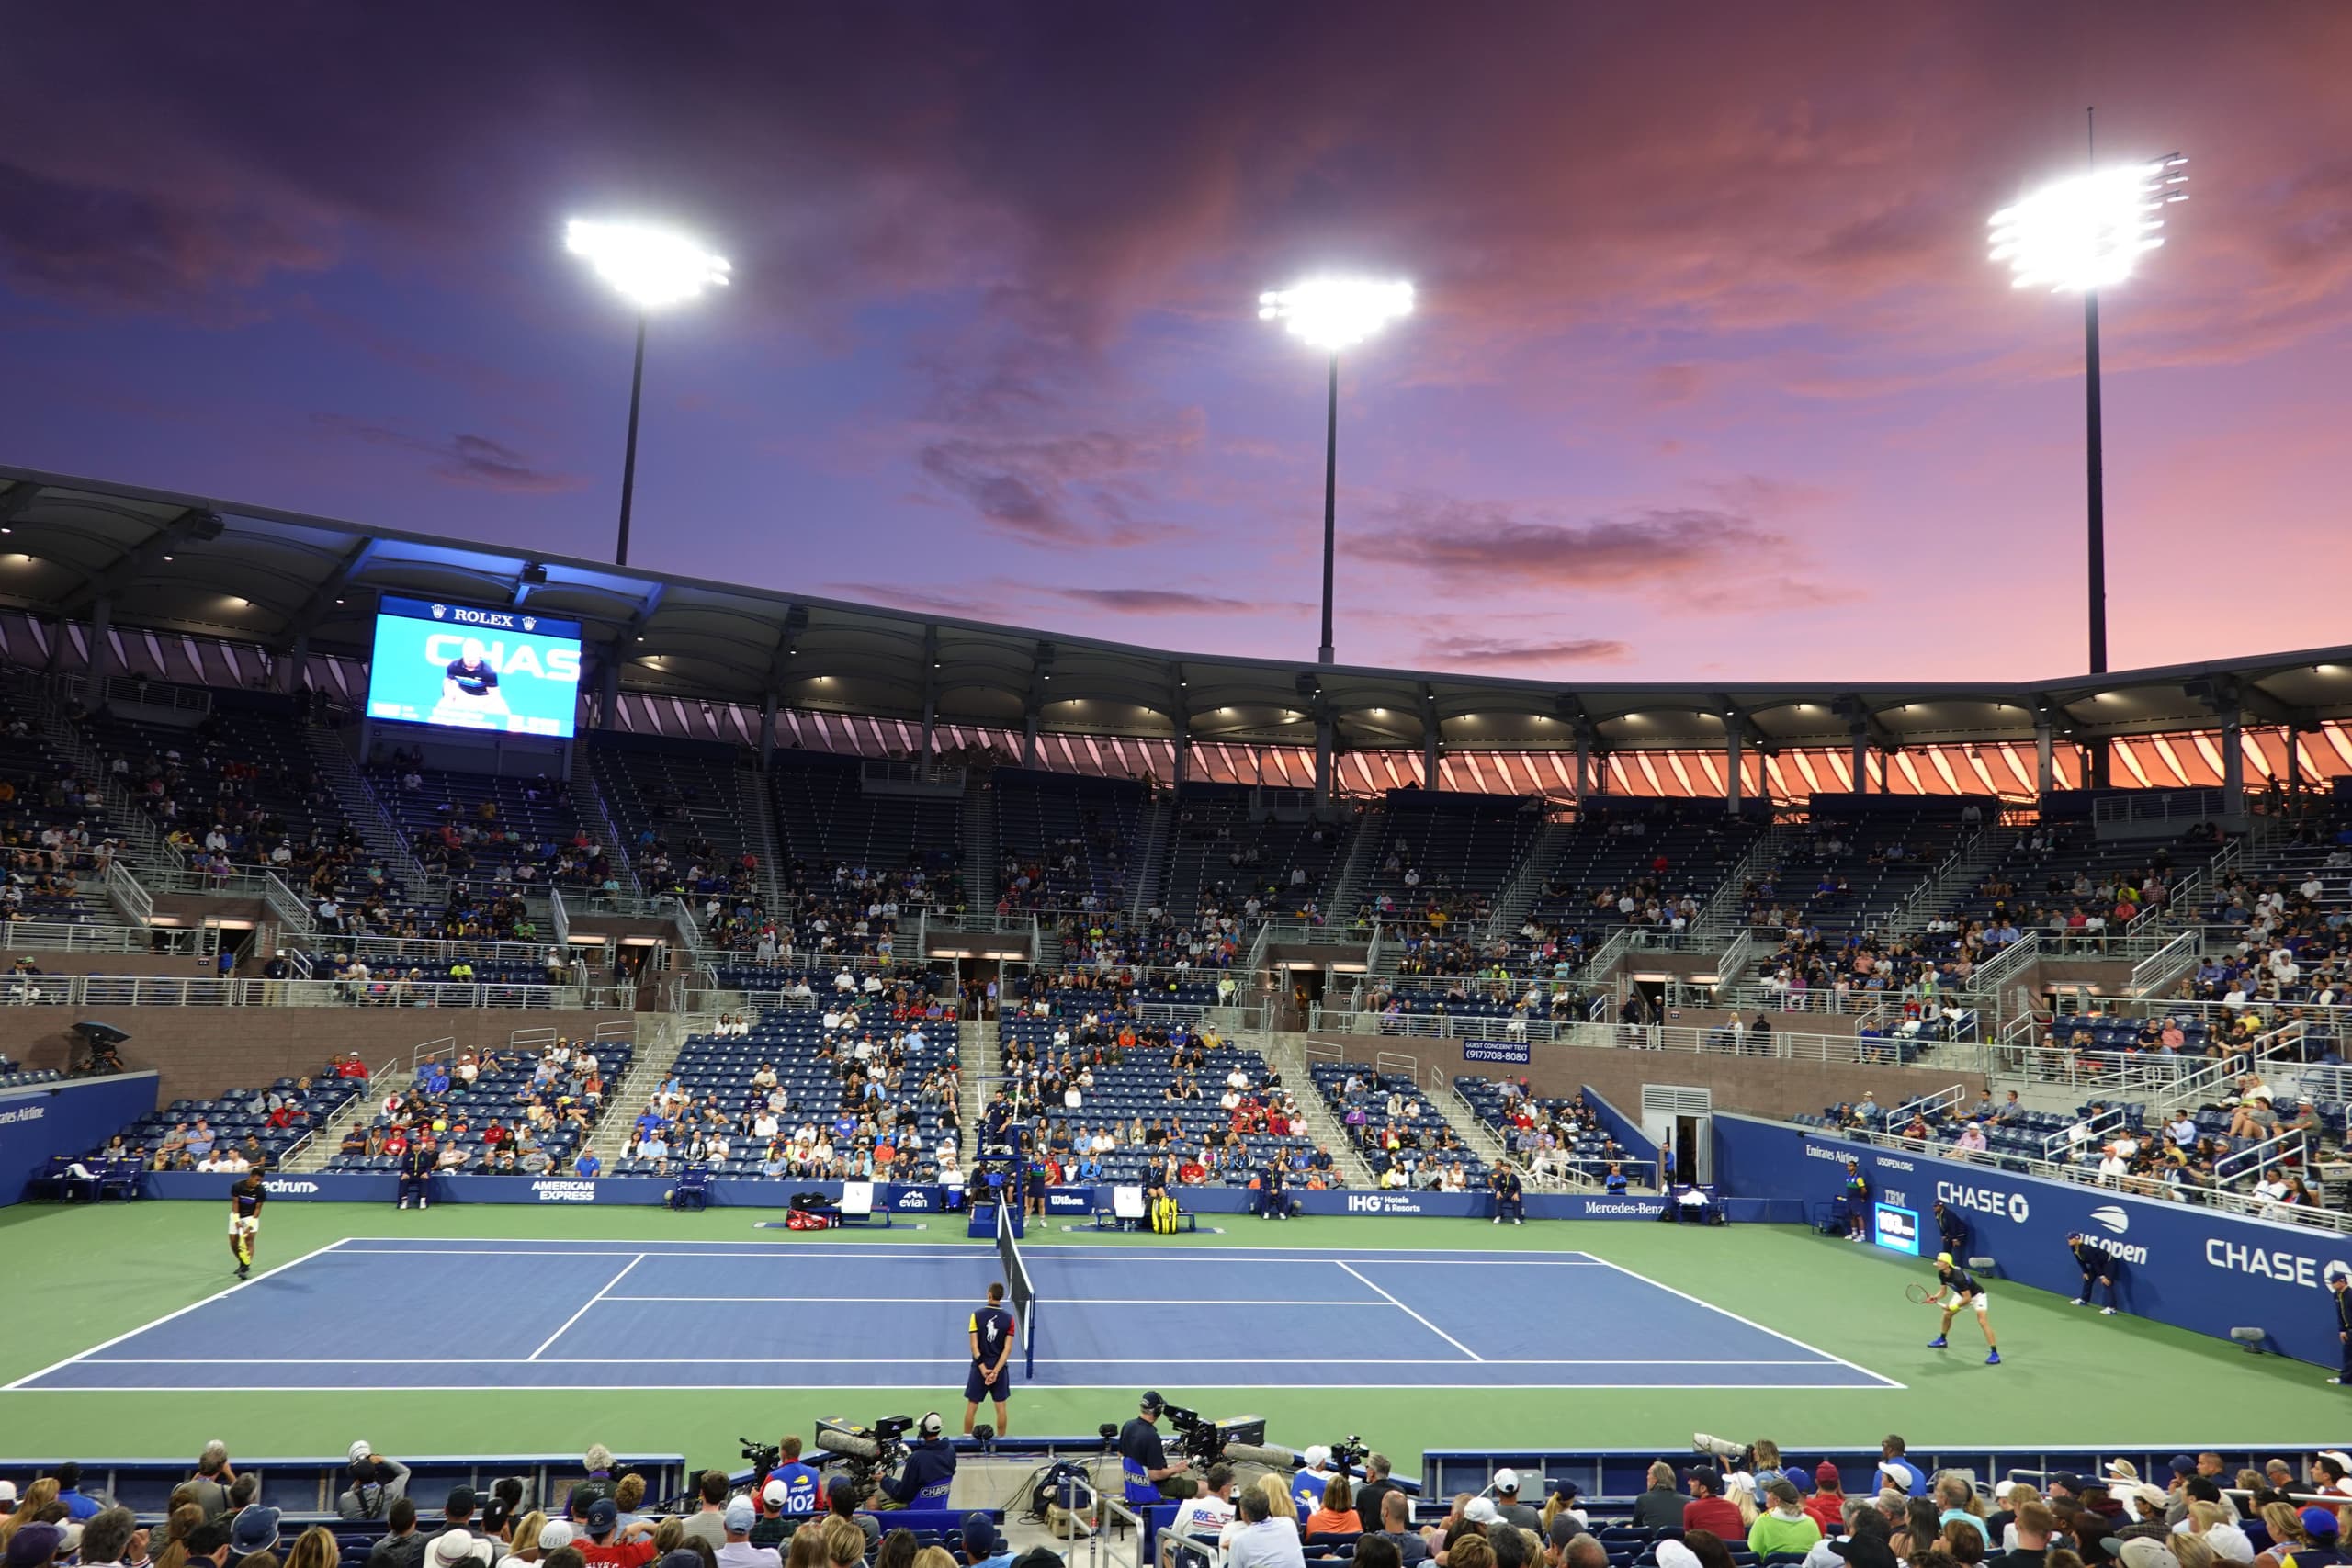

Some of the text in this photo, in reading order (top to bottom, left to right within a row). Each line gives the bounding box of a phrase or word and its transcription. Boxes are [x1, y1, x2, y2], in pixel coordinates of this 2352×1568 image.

[454, 608, 514, 627] ROLEX
[1465, 1050, 1528, 1061] (917)708-8080
[1805, 1145, 1835, 1160] Emirates
[1876, 1156, 1915, 1172] USOPEN.ORG
[261, 1179, 312, 1193] ectrum
[531, 1180, 595, 1191] AMERICAN
[539, 1190, 595, 1201] EXPRESS
[899, 1197, 928, 1208] evian
[1050, 1195, 1084, 1206] Wilson
[1884, 1189, 1906, 1208] IBM
[1937, 1180, 2007, 1216] CHASE
[1348, 1195, 1409, 1212] IHG Hotels
[1396, 1204, 1421, 1213] Resorts
[1585, 1201, 1665, 1215] Mercedes-Benz
[2206, 1238, 2319, 1289] CHASE
[786, 1493, 816, 1513] 102
